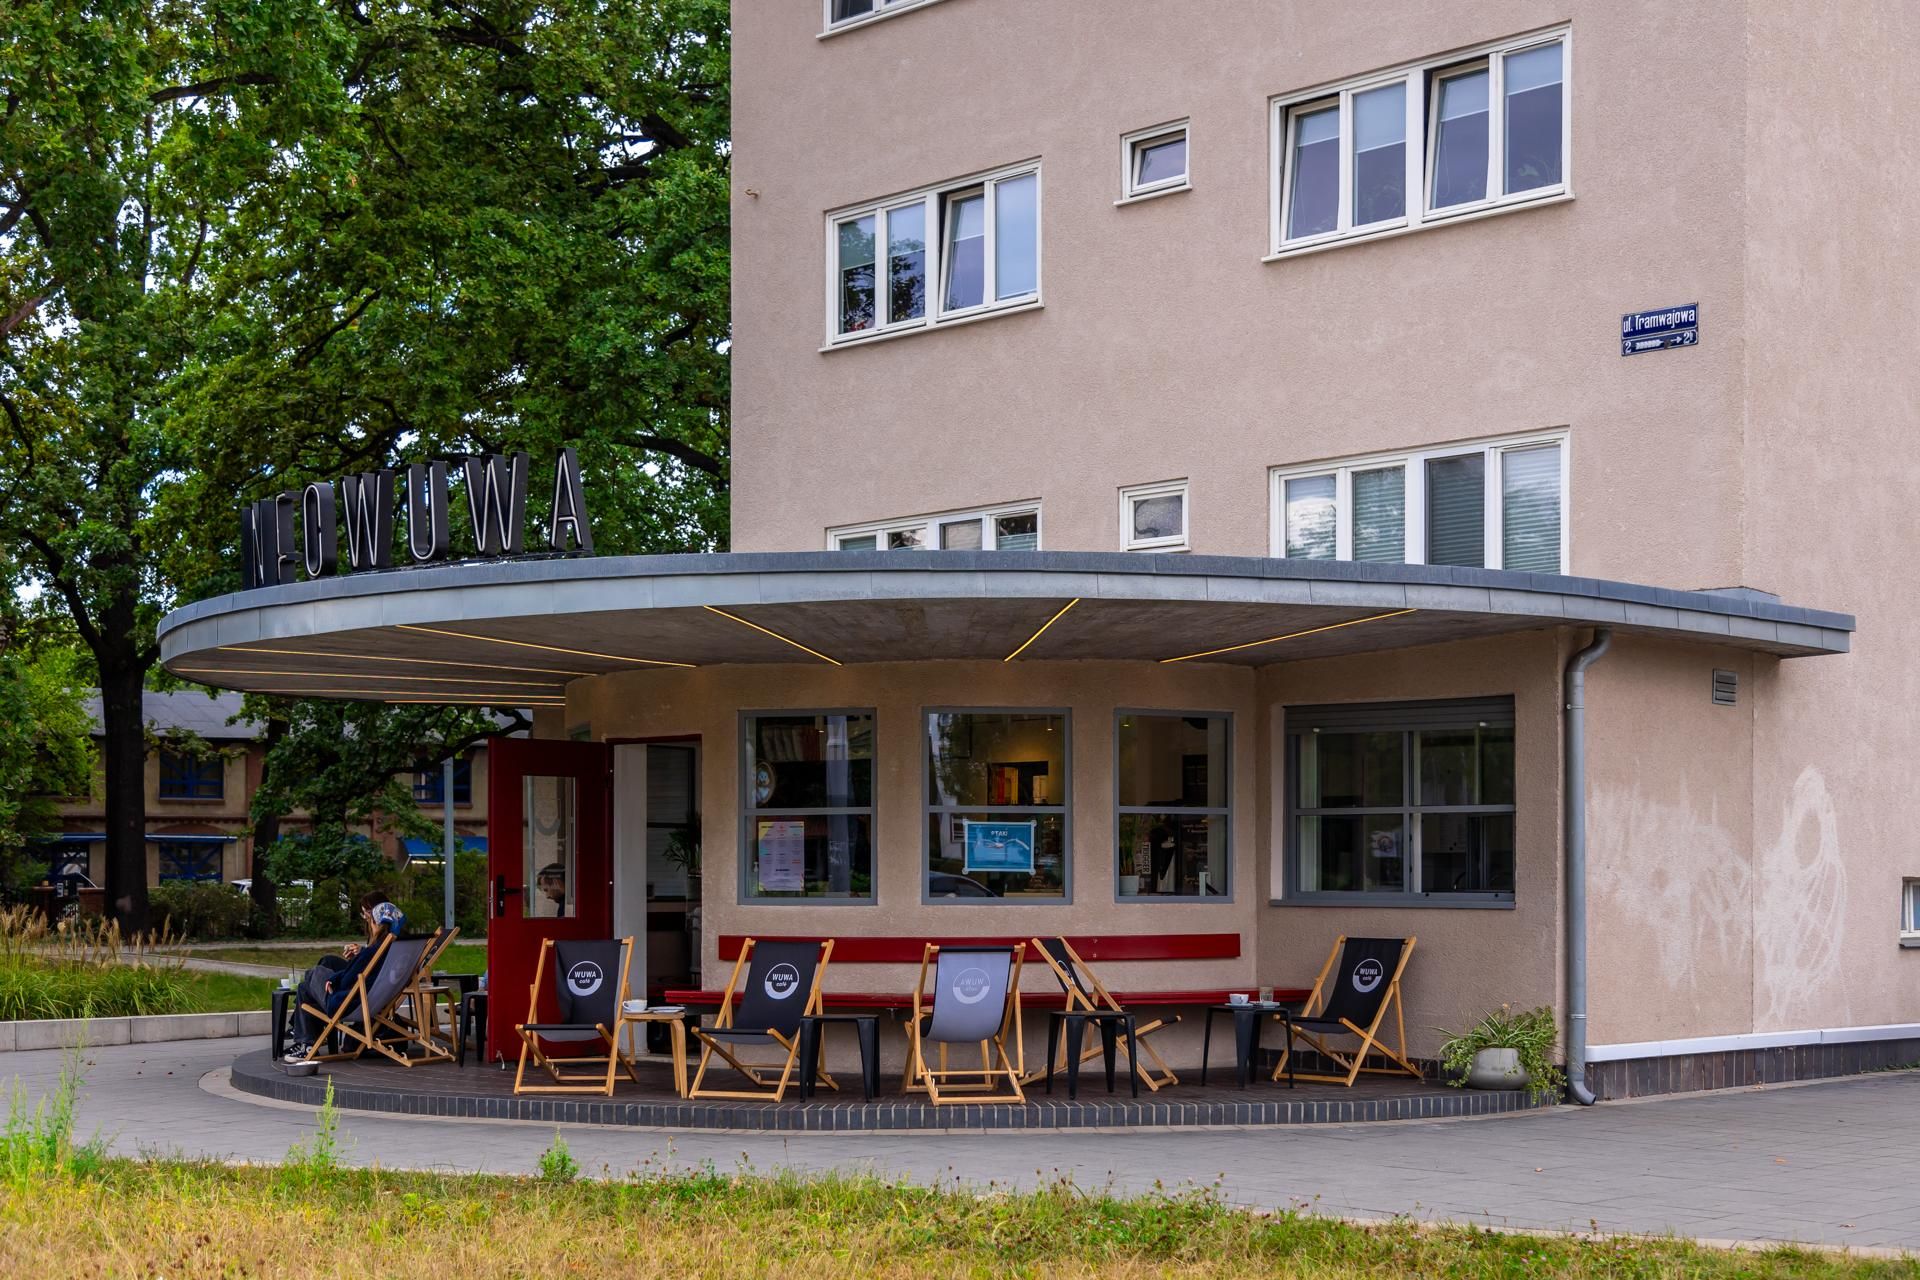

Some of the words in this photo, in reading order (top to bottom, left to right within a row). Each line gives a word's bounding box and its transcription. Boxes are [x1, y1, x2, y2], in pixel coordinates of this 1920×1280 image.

[1623, 316, 1633, 332] ul.
[1635, 309, 1695, 330] Tramwajowa
[1625, 341, 1632, 353] 2
[772, 973, 793, 981] WUWA
